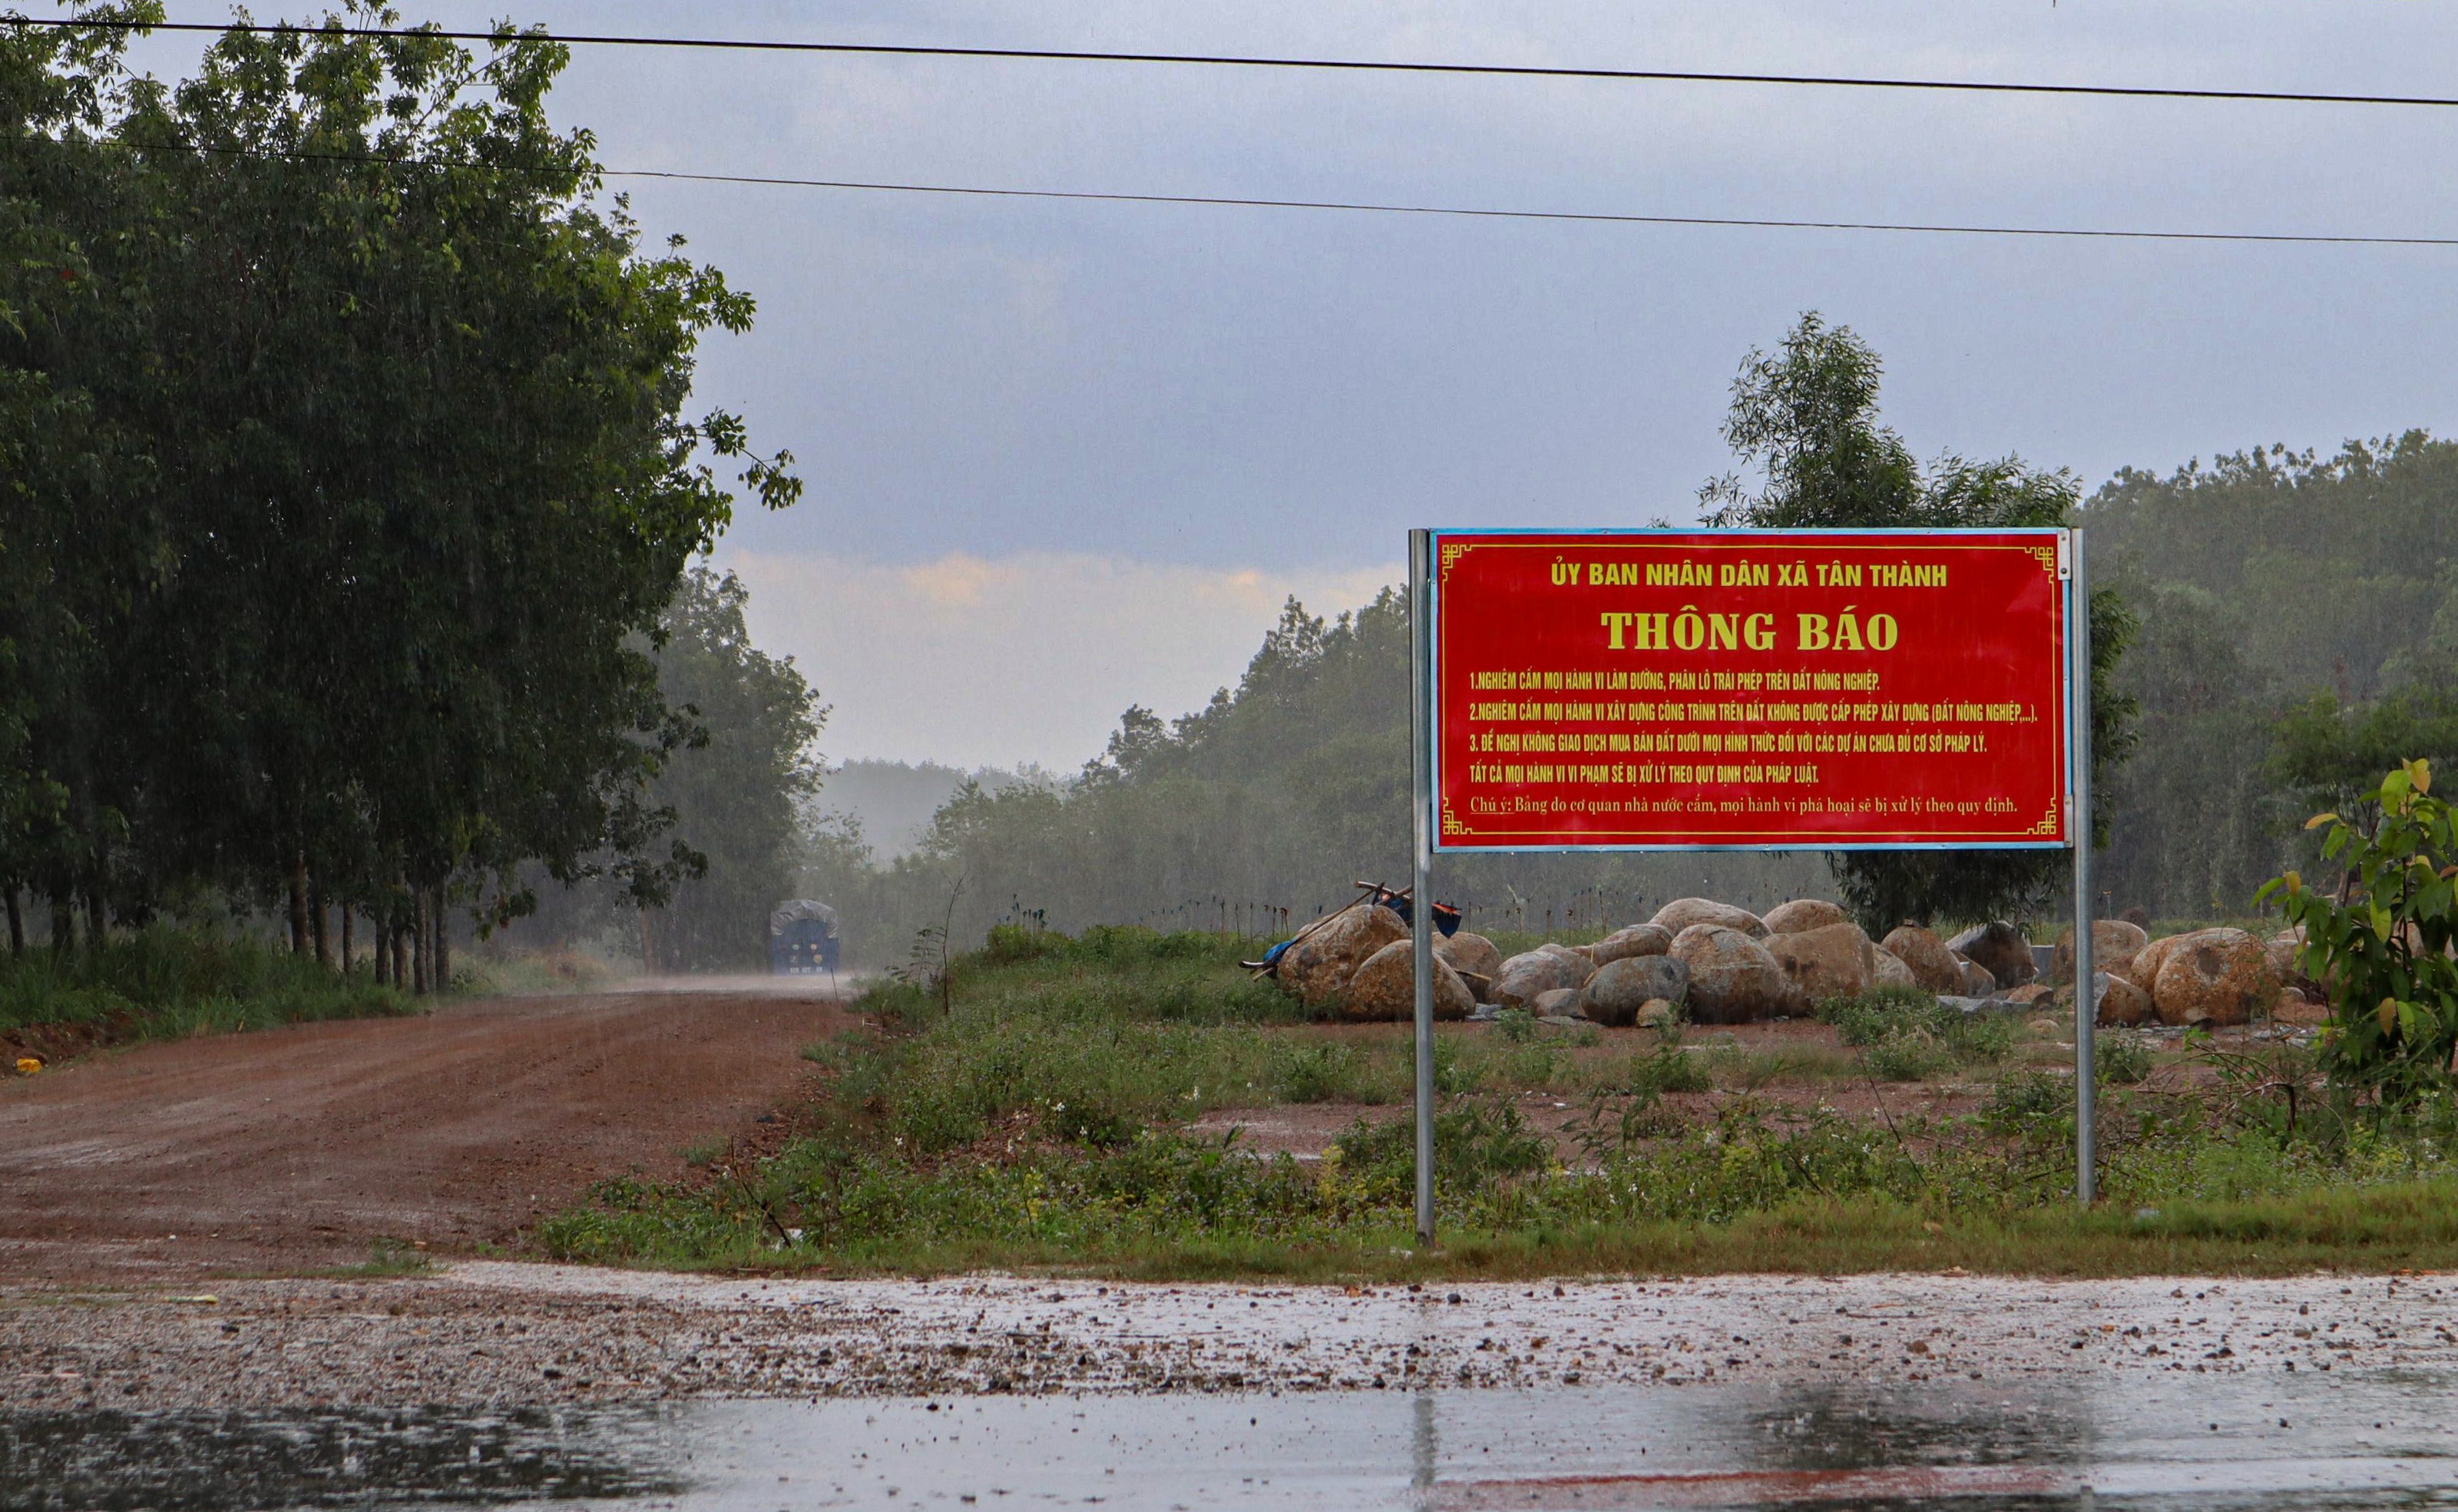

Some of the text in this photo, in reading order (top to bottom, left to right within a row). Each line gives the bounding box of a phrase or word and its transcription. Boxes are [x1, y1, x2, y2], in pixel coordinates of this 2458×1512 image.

[1552, 556, 1947, 587] ỦY BAN NHÂN DÂN XÃ TÂN THÀNH
[1601, 605, 1897, 650] THÔNG BÁO
[1520, 667, 1540, 690] CẤM
[1544, 672, 1563, 693] MỌI
[1566, 669, 1592, 690] HÀNH
[1595, 673, 1603, 690] VI
[1607, 669, 1627, 690] LÀM
[1630, 669, 1666, 691] ĐƯỜNG,
[1669, 669, 1695, 690] PHÂN
[1699, 670, 1710, 690] LÔ
[1713, 670, 1734, 690] TRÁI
[1738, 670, 1762, 690] PHÉP
[1765, 670, 1790, 690] TRÊN
[1793, 667, 1811, 690] ĐẤT
[1814, 670, 1840, 690] NÔNG
[1844, 670, 1879, 694] NGHIỆP.
[1520, 698, 1540, 720] CẤM
[1544, 703, 1563, 724] MỌI
[1566, 700, 1592, 720] HÀNH
[1595, 703, 1604, 720] VI
[1607, 700, 1626, 720] XÂY
[1629, 702, 1655, 724] DỰNG
[1659, 700, 1684, 720] CÔNG
[1687, 700, 1715, 720] TRÌNH
[1719, 700, 1743, 721] TRÊN
[1746, 698, 1764, 721] ĐẤT
[1768, 700, 1800, 721] KHÔNG
[1803, 703, 1828, 725] ĐƯỢC
[1831, 698, 1851, 721] CẤP
[1854, 700, 1878, 721] PHÉP
[1881, 700, 1899, 721] XÂY
[1903, 703, 1929, 725] DỰNG
[1932, 698, 1953, 723] (ĐẤT
[1957, 701, 1983, 721] NÔNG
[1470, 734, 1478, 751] 3.
[1497, 734, 1519, 755] NGHỊ
[1523, 731, 1555, 751] KHÔNG
[1558, 734, 1580, 751] GIAO
[1584, 734, 1606, 755] DỊCH
[1609, 734, 1630, 752] MUA
[1634, 731, 1653, 752] BÁN
[1656, 729, 1674, 751] ĐẤT
[1678, 731, 1699, 752] DƯỚI
[1703, 735, 1722, 756] MỌI
[1725, 731, 1748, 752] HÌNH
[1751, 731, 1775, 752] THỨC
[1778, 729, 1794, 752] ĐỐI
[1797, 731, 1812, 752] VỚI
[1815, 732, 1834, 752] CÁC
[1838, 733, 1851, 756] DỰ
[1853, 732, 1866, 752] ÁN
[1870, 733, 1895, 752] CHƯA
[1897, 729, 1910, 752] ĐỦ
[1914, 733, 1927, 752] CƠ
[1930, 730, 1942, 752] SỞ
[1945, 732, 1970, 752] PHÁP
[1973, 731, 1987, 752] LÝ.
[1470, 759, 1818, 786] TẤT CẢ MỌI HÀNH VI VI PHẠM SẼ BỊ XỬ LÝ THEO QUY ĐỊNH CỦA PHÁP LUẬT.
[1471, 797, 1496, 814] Chú
[1500, 798, 1511, 815] ý:
[1516, 796, 1547, 814] Bảng
[1551, 796, 1566, 811] do
[1570, 799, 1584, 811] cơ
[1589, 802, 1619, 815] quan
[1625, 797, 1647, 811] nhà
[1653, 798, 1682, 811] nước
[1721, 798, 1743, 816] mọi
[1748, 797, 1779, 811] hành
[1785, 798, 1795, 811] vi
[1800, 797, 1823, 815] phá
[1828, 798, 1854, 816] hoại
[1859, 799, 1871, 812] sẽ
[1875, 797, 1887, 816] bị
[1892, 796, 1907, 812] xử
[1911, 797, 1921, 815] lý
[1927, 797, 1953, 812] theo
[1958, 802, 1980, 815] quy
[1985, 797, 2016, 816] định.
